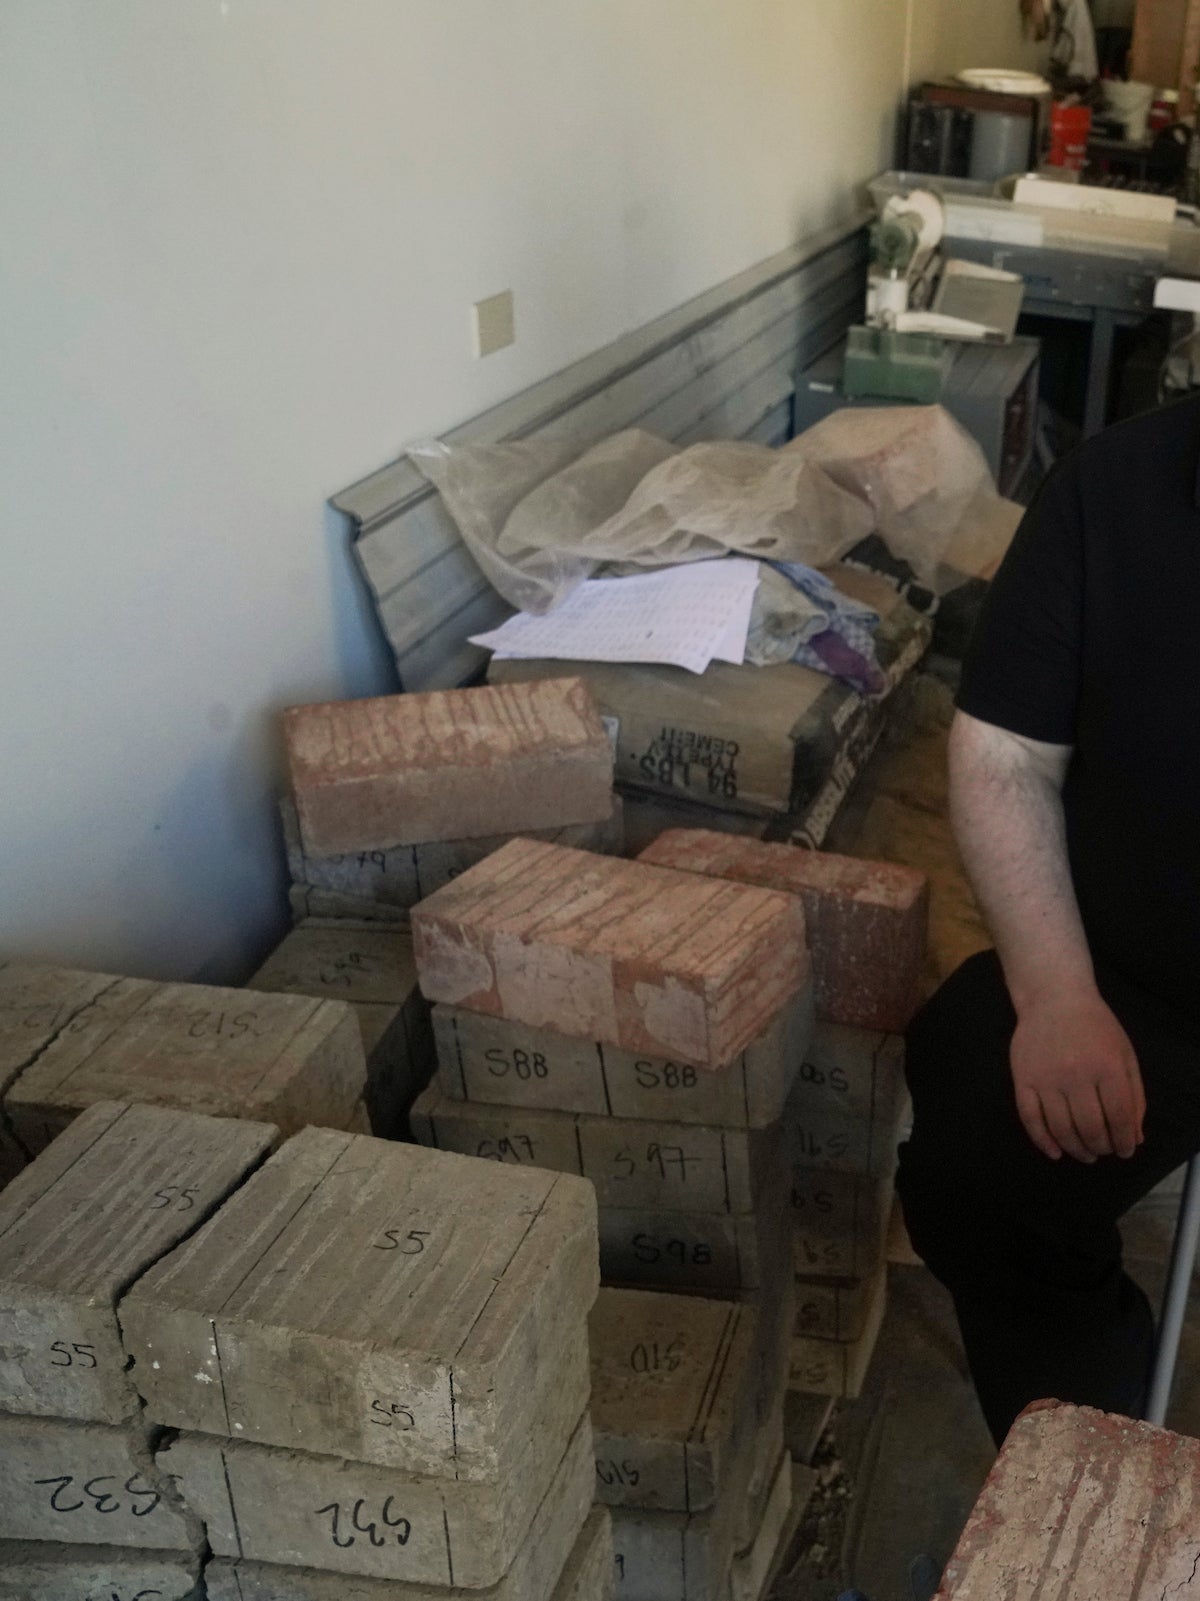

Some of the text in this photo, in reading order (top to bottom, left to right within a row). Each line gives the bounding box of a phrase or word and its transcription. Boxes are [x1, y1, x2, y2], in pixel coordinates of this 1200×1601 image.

[706, 767, 738, 800] 94
[484, 1048, 549, 1081] S88
[634, 1059, 699, 1089] S88
[613, 1141, 703, 1183] S97
[150, 1185, 200, 1212] S5
[372, 1229, 431, 1255] S5
[632, 1233, 712, 1266] S98
[49, 1341, 99, 1370] S5
[369, 1399, 416, 1432] S5
[33, 1472, 183, 1517] S32
[313, 1494, 412, 1549] S32
